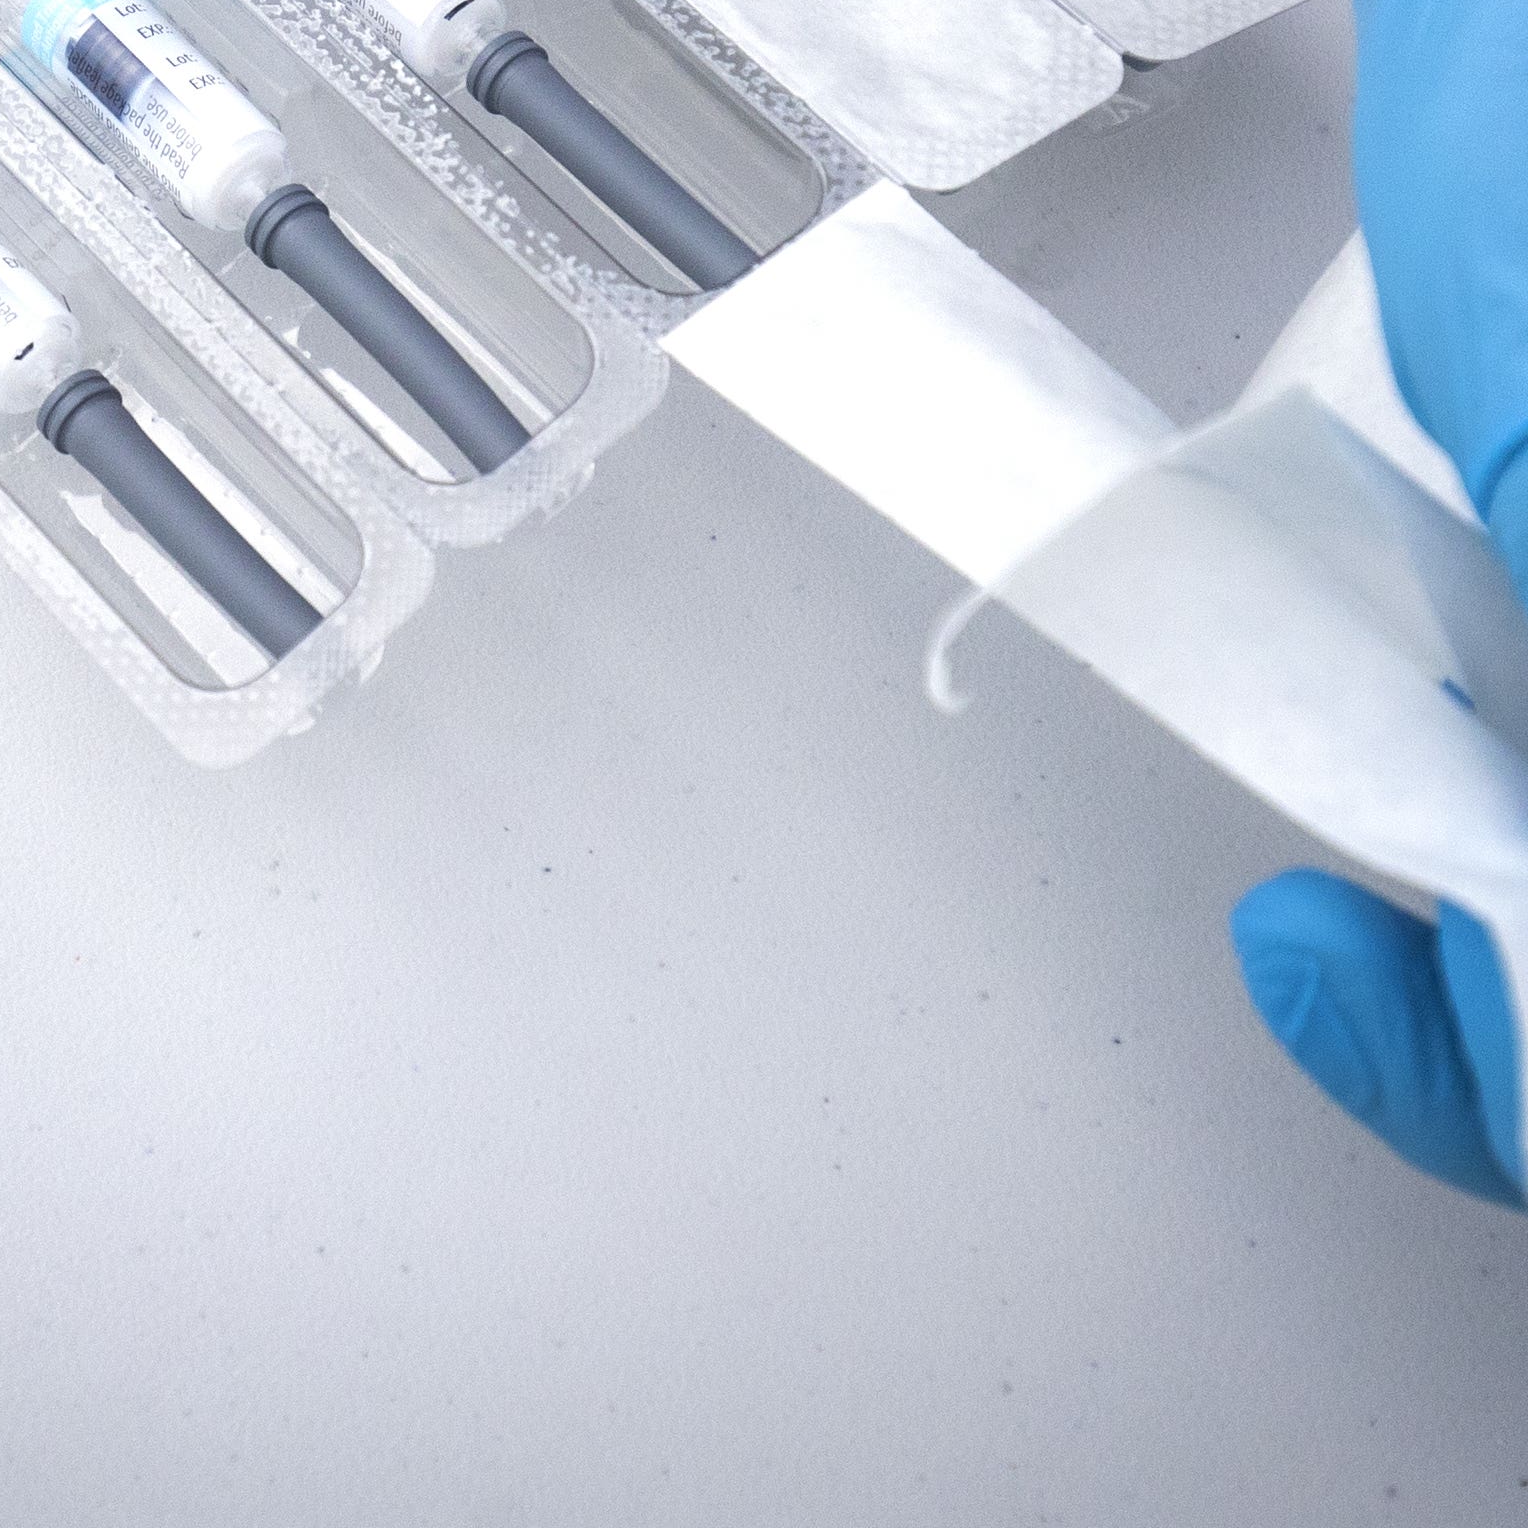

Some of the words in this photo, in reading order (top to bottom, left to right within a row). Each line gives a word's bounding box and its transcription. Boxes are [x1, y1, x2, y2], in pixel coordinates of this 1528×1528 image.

[114, 3, 147, 17] Lot:
[369, 8, 403, 43] before
[165, 53, 198, 67] Lot:
[100, 82, 146, 129] package
[146, 95, 170, 123] use.
[143, 123, 163, 150] the
[166, 117, 203, 162] before
[159, 144, 190, 179] Read
